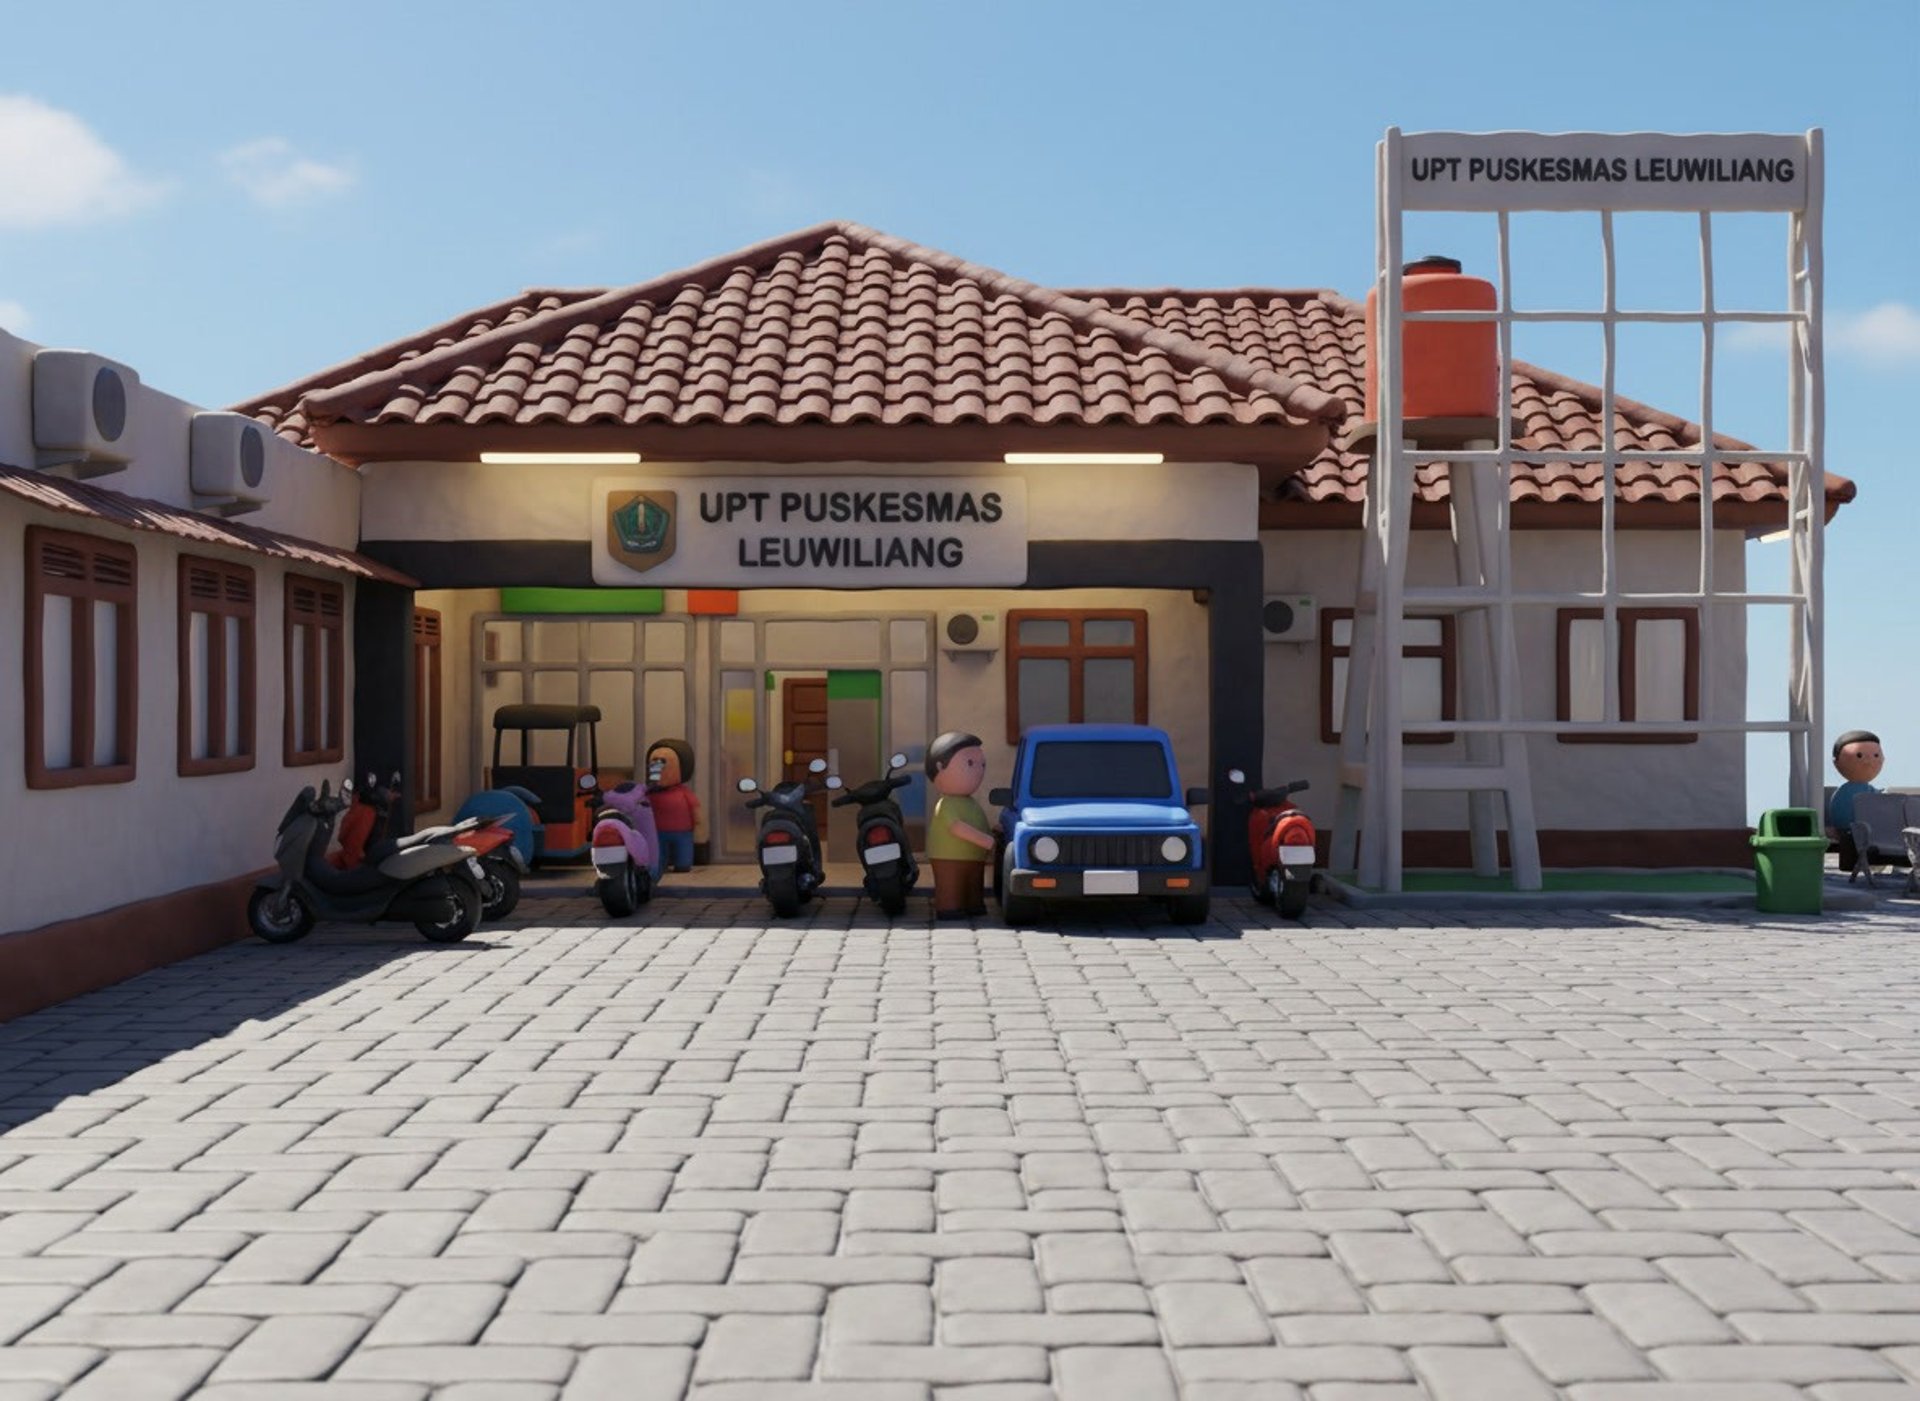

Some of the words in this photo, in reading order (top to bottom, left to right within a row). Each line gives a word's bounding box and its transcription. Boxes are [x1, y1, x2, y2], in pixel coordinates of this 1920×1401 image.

[1411, 157, 1462, 182] UPT
[1469, 157, 1628, 182] PUSKESMAS
[1635, 157, 1795, 182] LEUWILIANG
[699, 491, 770, 523] UPT
[780, 491, 1003, 524] PUSKESMAS
[738, 537, 964, 568] LEUWILIANG
